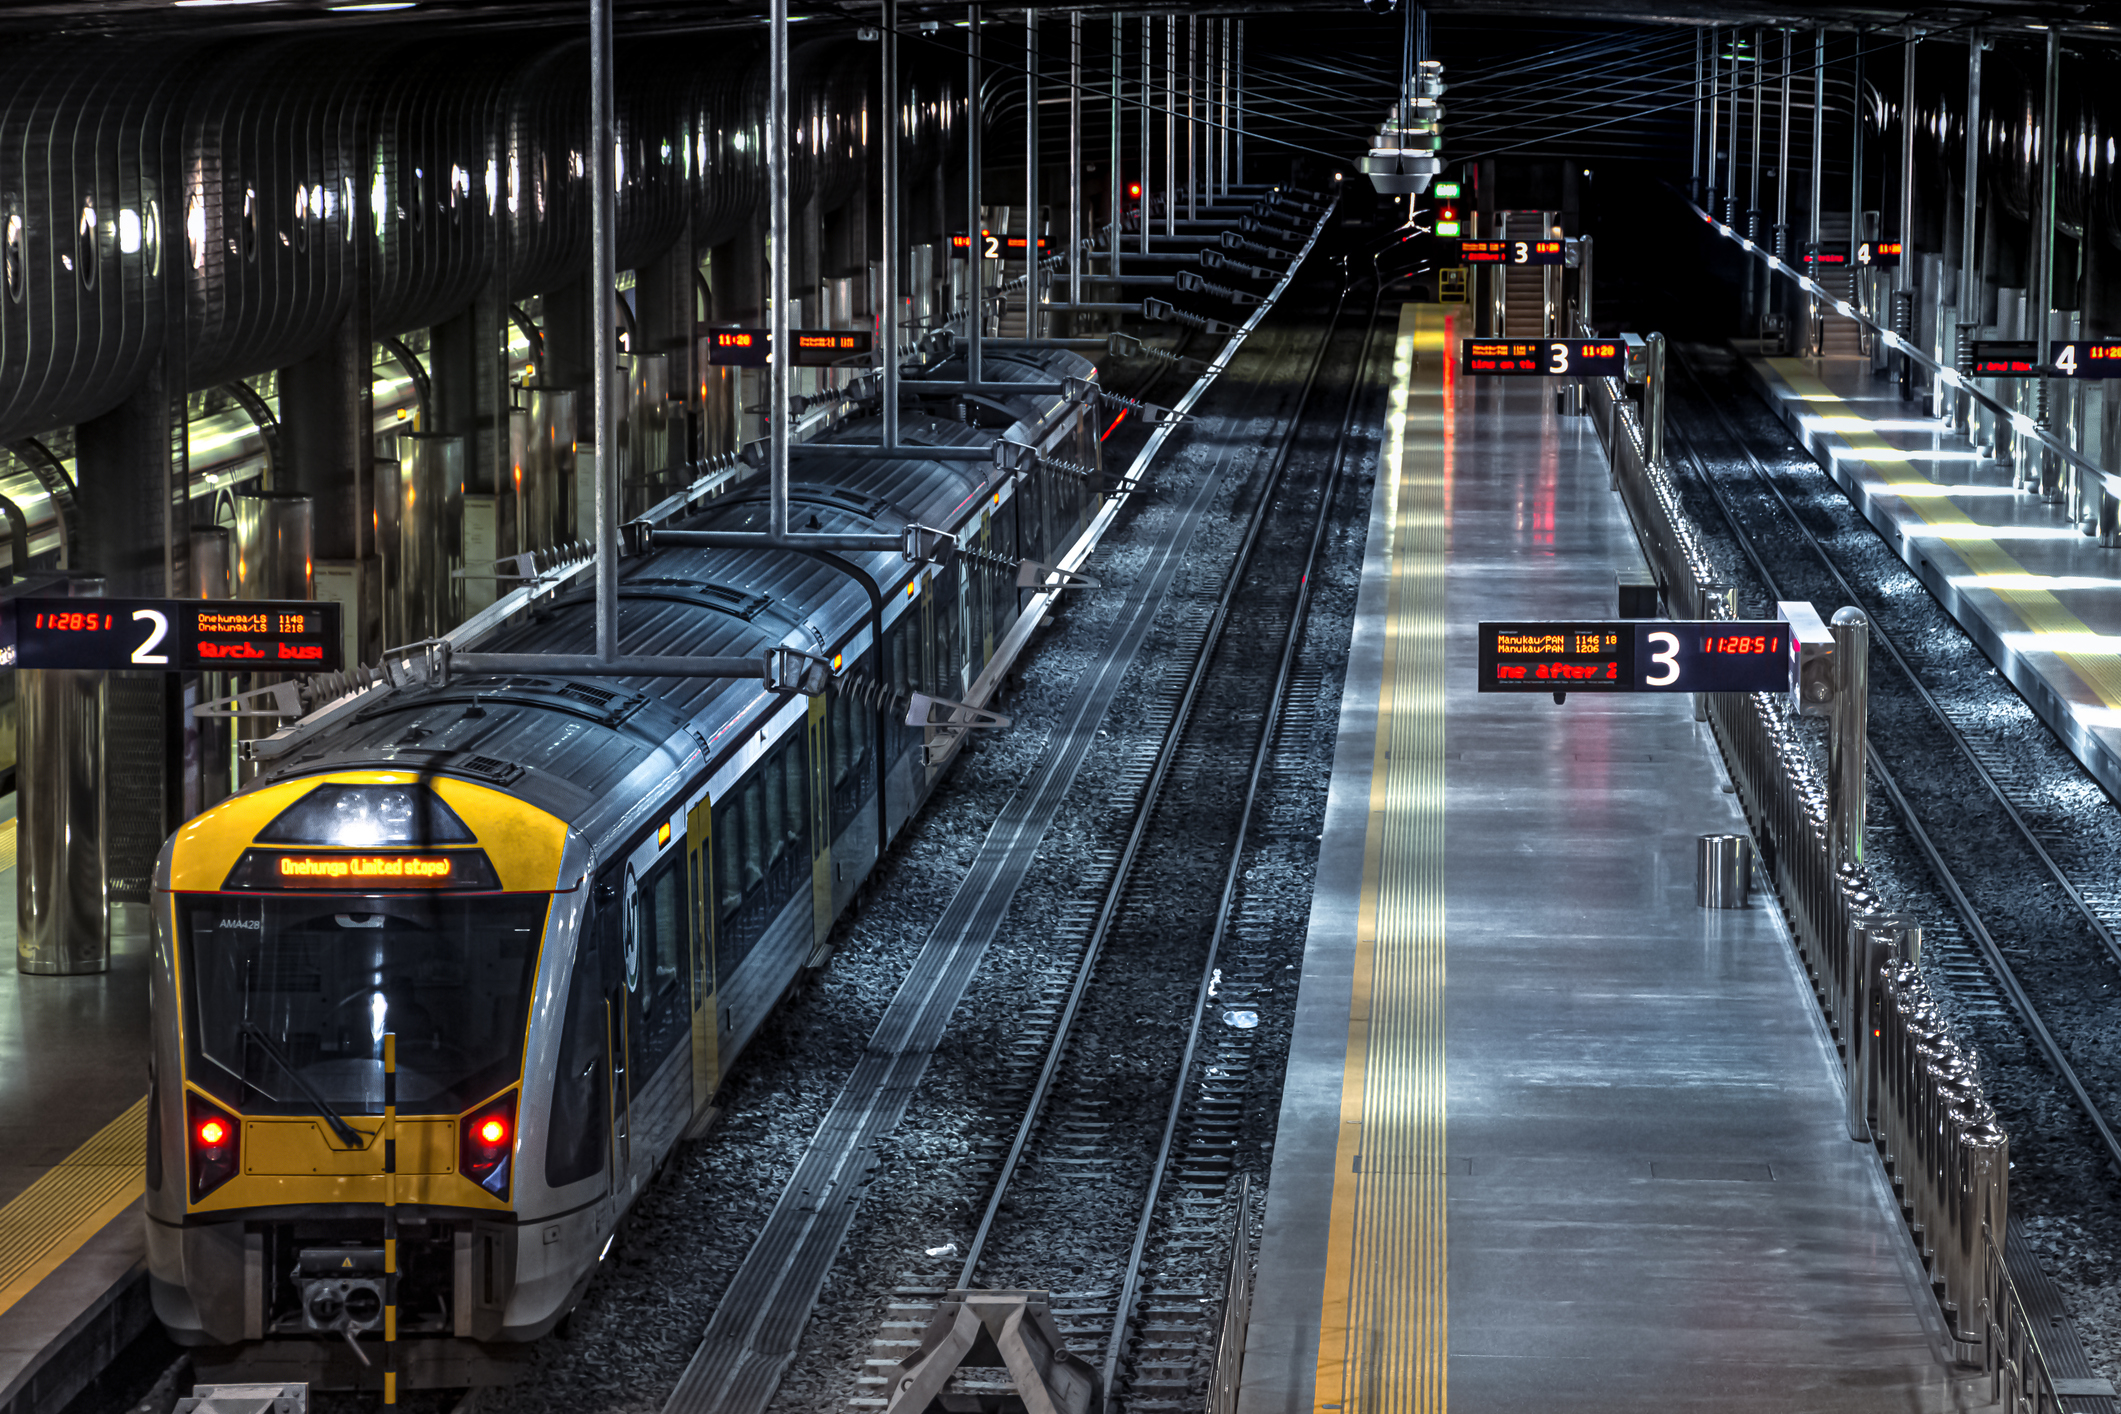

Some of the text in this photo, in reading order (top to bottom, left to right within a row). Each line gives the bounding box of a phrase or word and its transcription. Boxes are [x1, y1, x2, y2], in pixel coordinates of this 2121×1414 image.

[985, 237, 999, 258] 2
[1514, 241, 1529, 263] 3
[1858, 243, 1871, 265] 4
[619, 331, 630, 353] 1
[1549, 343, 1569, 374] 3
[2055, 344, 2077, 375] 4
[35, 612, 113, 631] 11:28:51
[198, 613, 305, 624] Onehunga/LS 1148
[198, 622, 305, 633] Onehunga/LS 1218
[131, 609, 169, 664] 2
[1497, 634, 1618, 645] Manukau/PAN 1146 18
[1705, 635, 1779, 655] 11:28:51
[1497, 644, 1600, 654] Manukau/PAN 1206
[1646, 631, 1681, 687] 3
[1535, 661, 1598, 679] after
[281, 858, 450, 877] Onehunga (Limited stops)
[219, 919, 260, 930] AMA428
